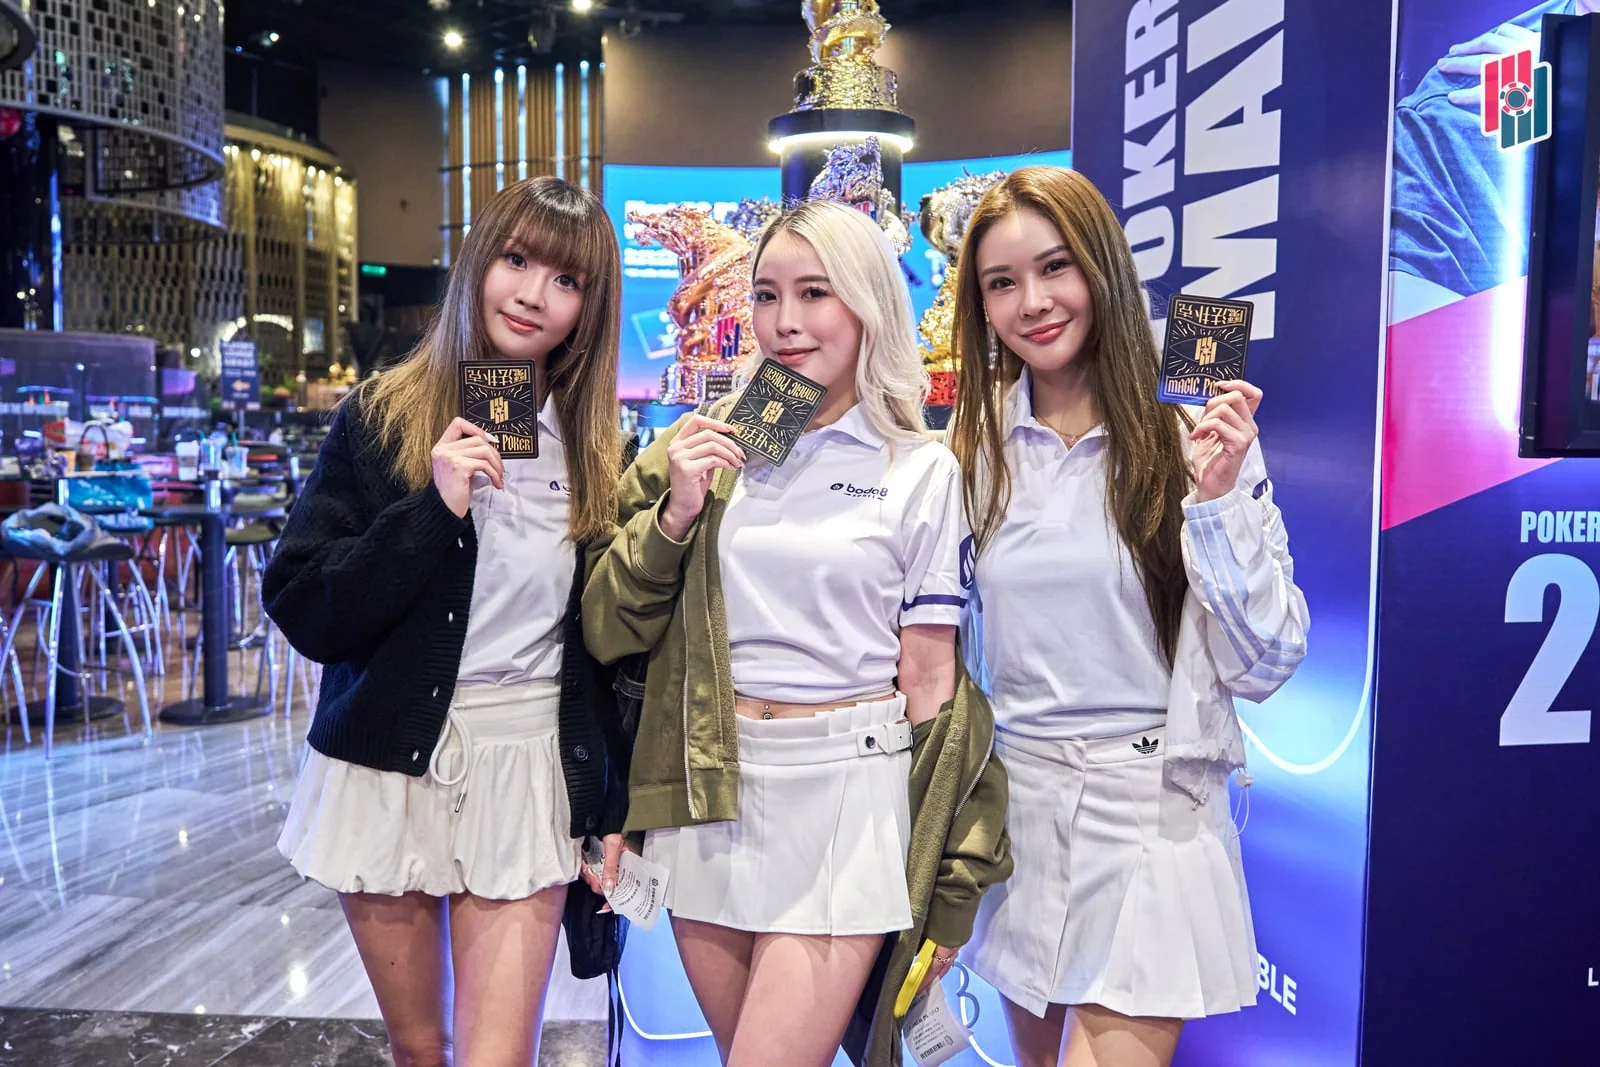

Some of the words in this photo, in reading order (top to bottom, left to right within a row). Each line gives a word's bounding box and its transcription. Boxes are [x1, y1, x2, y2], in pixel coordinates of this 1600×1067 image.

[1122, 0, 1180, 362] OKER
[1178, 302, 1244, 326] 魔法扑克
[466, 368, 528, 387] 魔法扑克
[763, 367, 792, 393] POKER
[1167, 376, 1201, 397] MAGIC
[787, 381, 819, 402] MAGIC
[502, 433, 532, 452] POKER
[846, 483, 889, 497] boda8
[1520, 510, 1600, 544] POKER
[1499, 552, 1600, 747] 2
